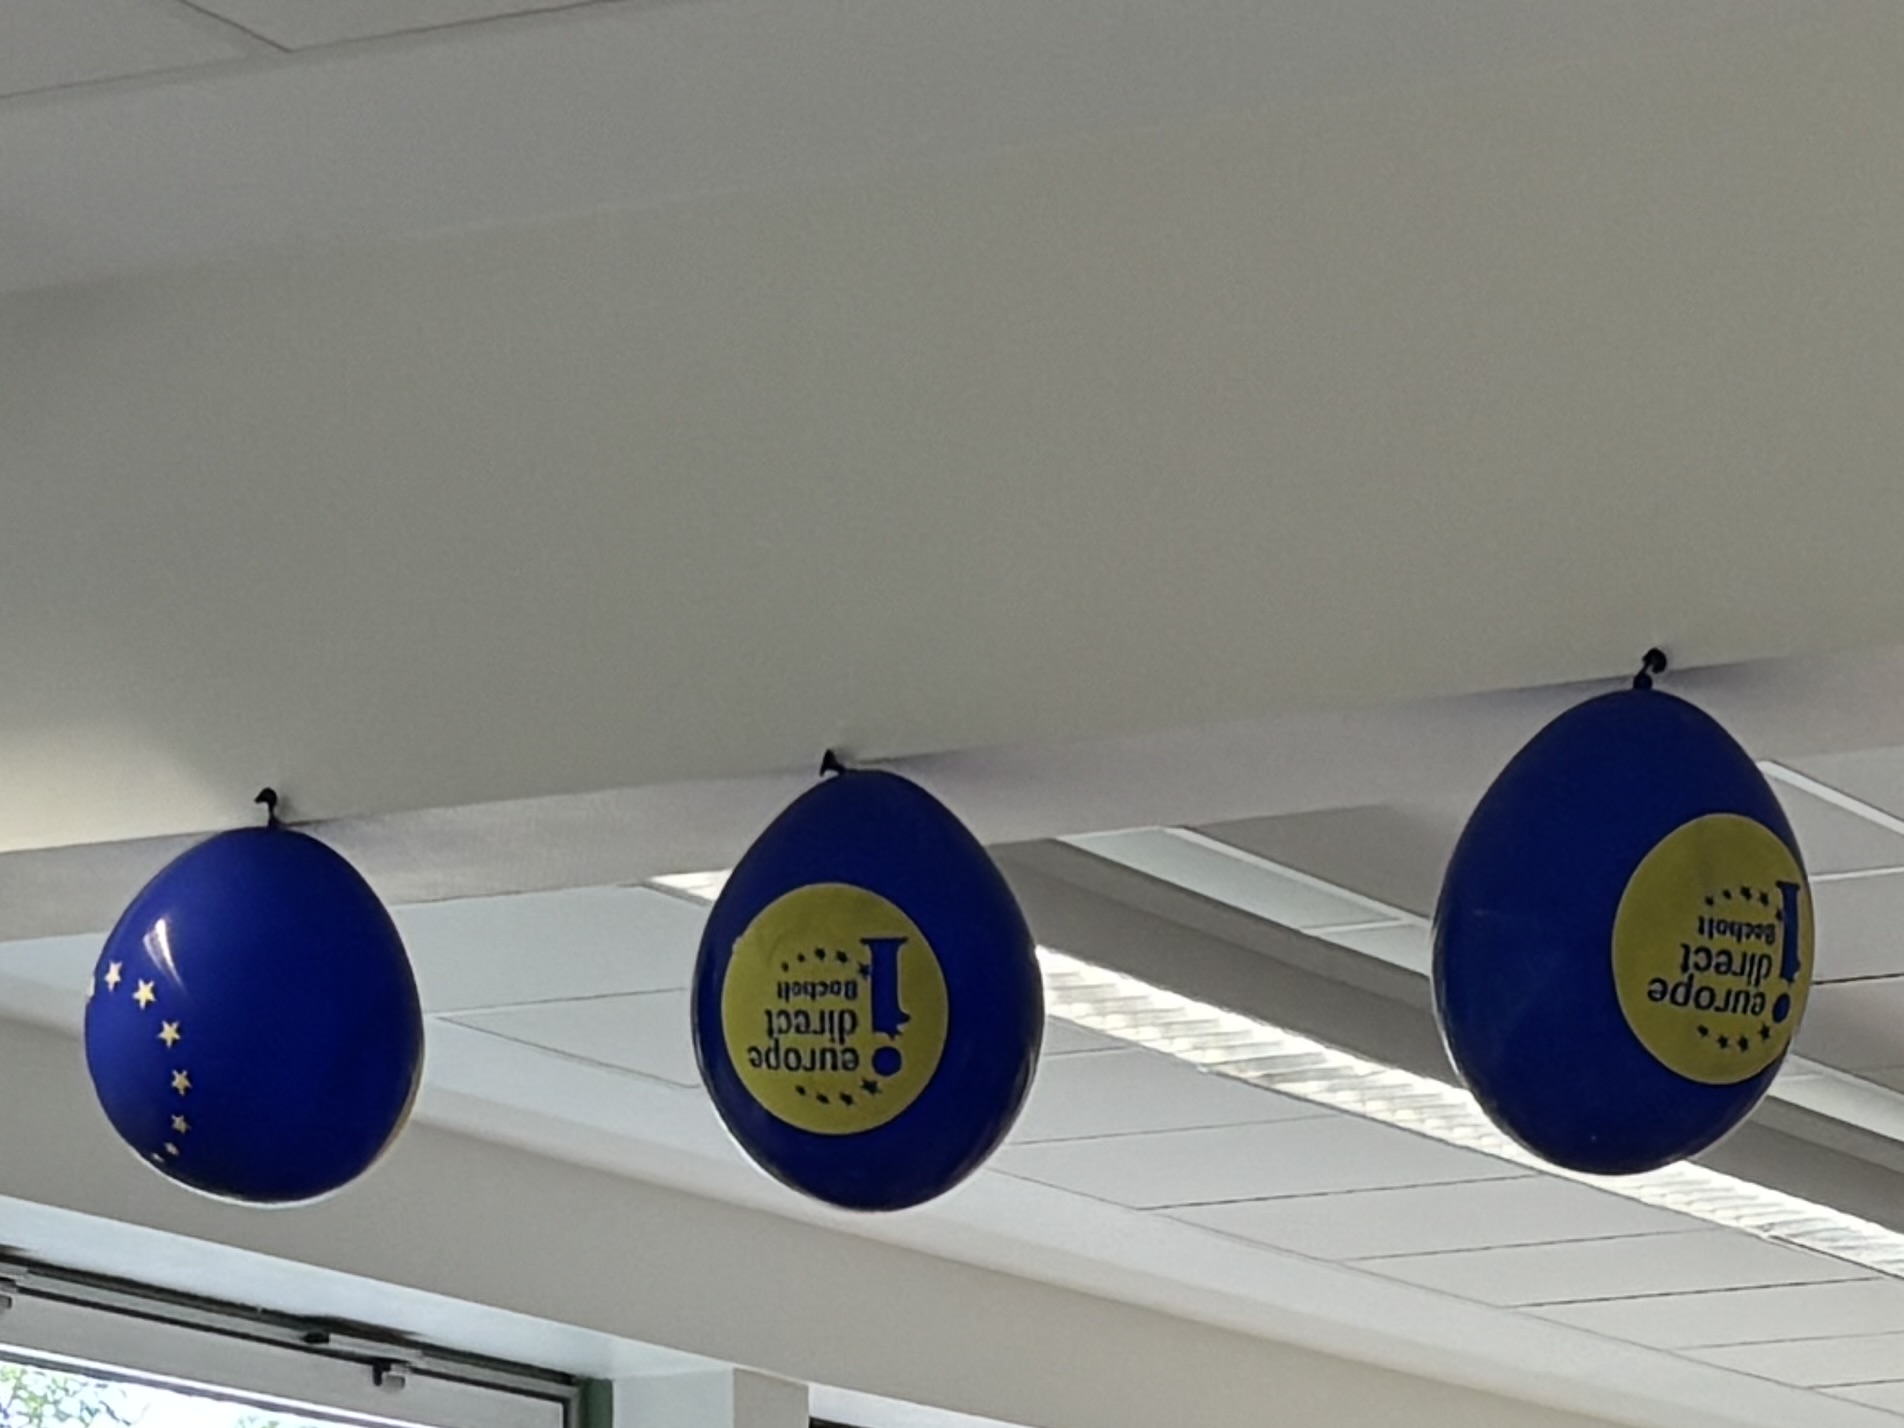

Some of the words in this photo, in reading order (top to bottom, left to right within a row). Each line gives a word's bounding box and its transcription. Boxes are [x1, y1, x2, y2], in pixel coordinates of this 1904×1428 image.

[1681, 943, 1772, 988] direct
[1647, 973, 1766, 1016] europe
[766, 1009, 858, 1045] direct
[747, 1037, 859, 1071] europe
